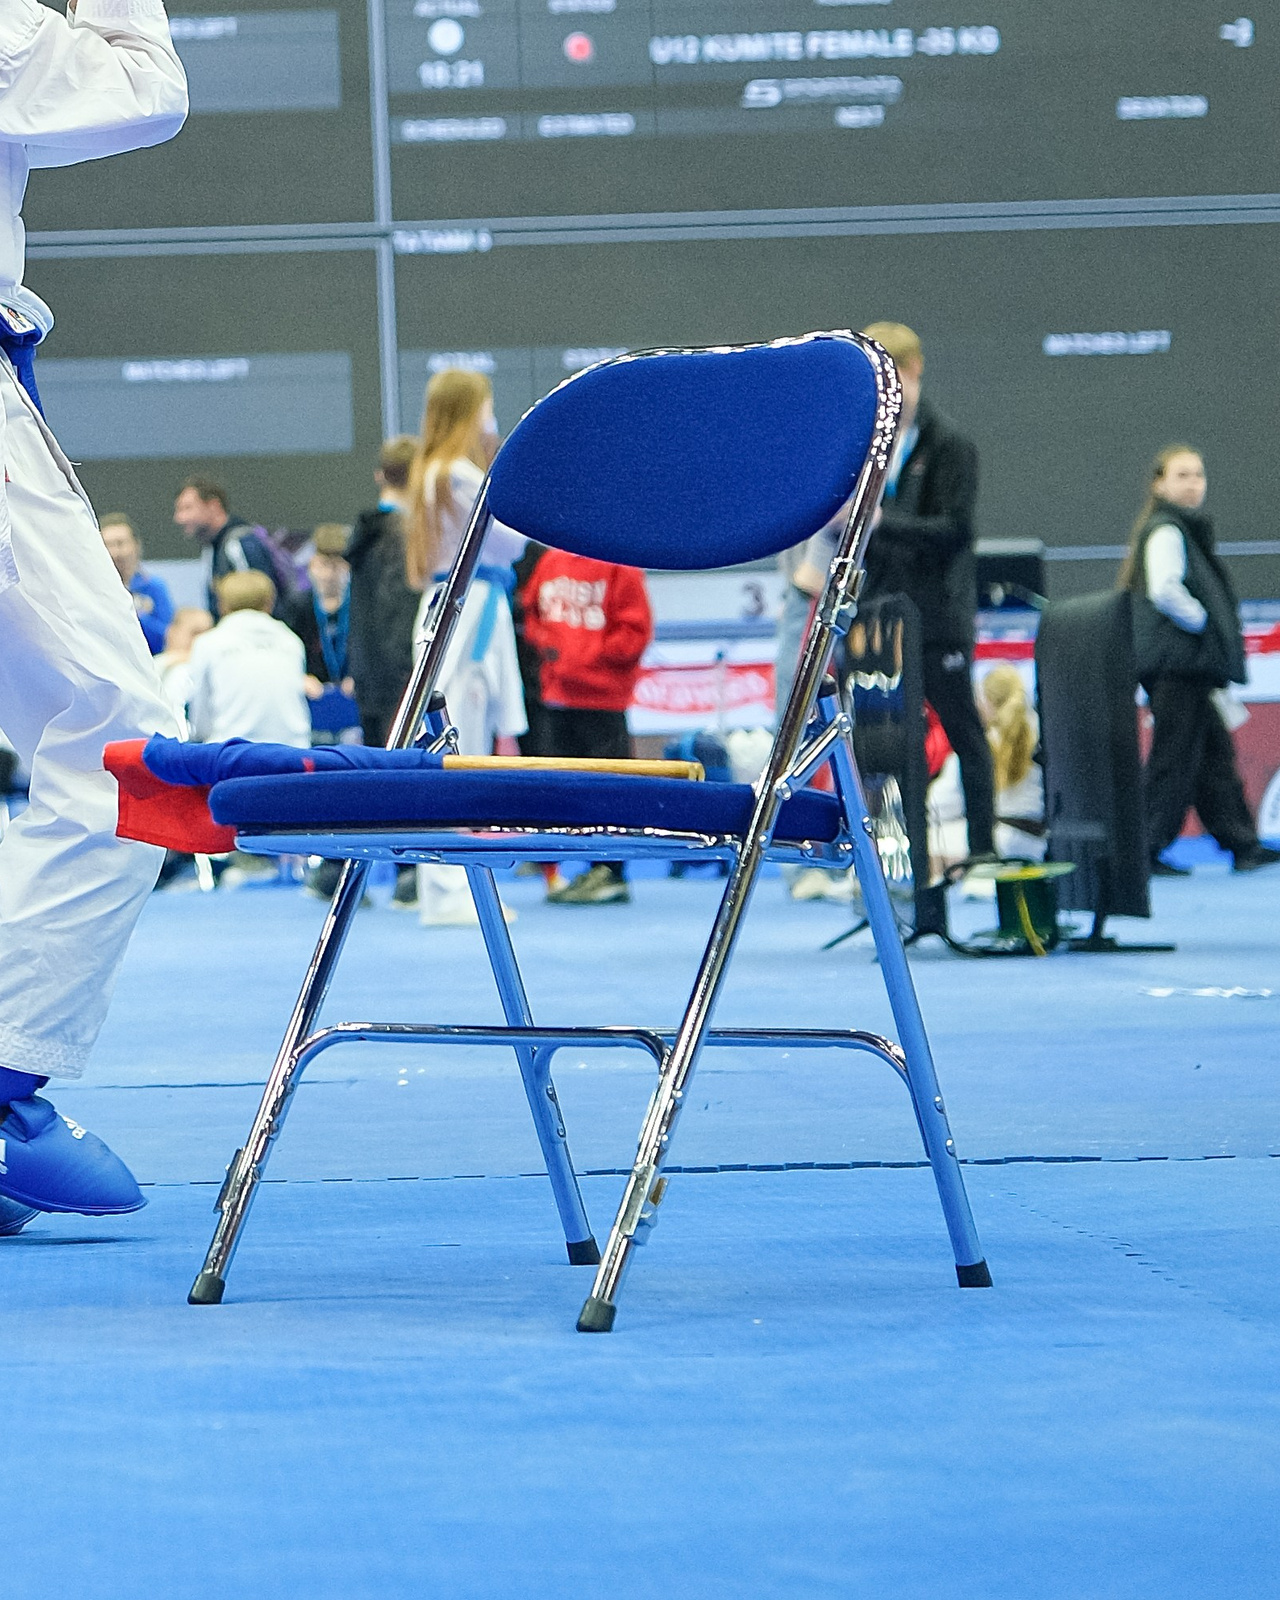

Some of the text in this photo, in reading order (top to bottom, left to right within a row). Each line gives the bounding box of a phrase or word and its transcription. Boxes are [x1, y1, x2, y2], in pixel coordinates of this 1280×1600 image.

[649, 35, 699, 64] U12
[701, 32, 803, 62] KUMITE
[805, 28, 914, 60] FEMALE
[957, 25, 1000, 54] KG
[741, 581, 765, 618] 3
